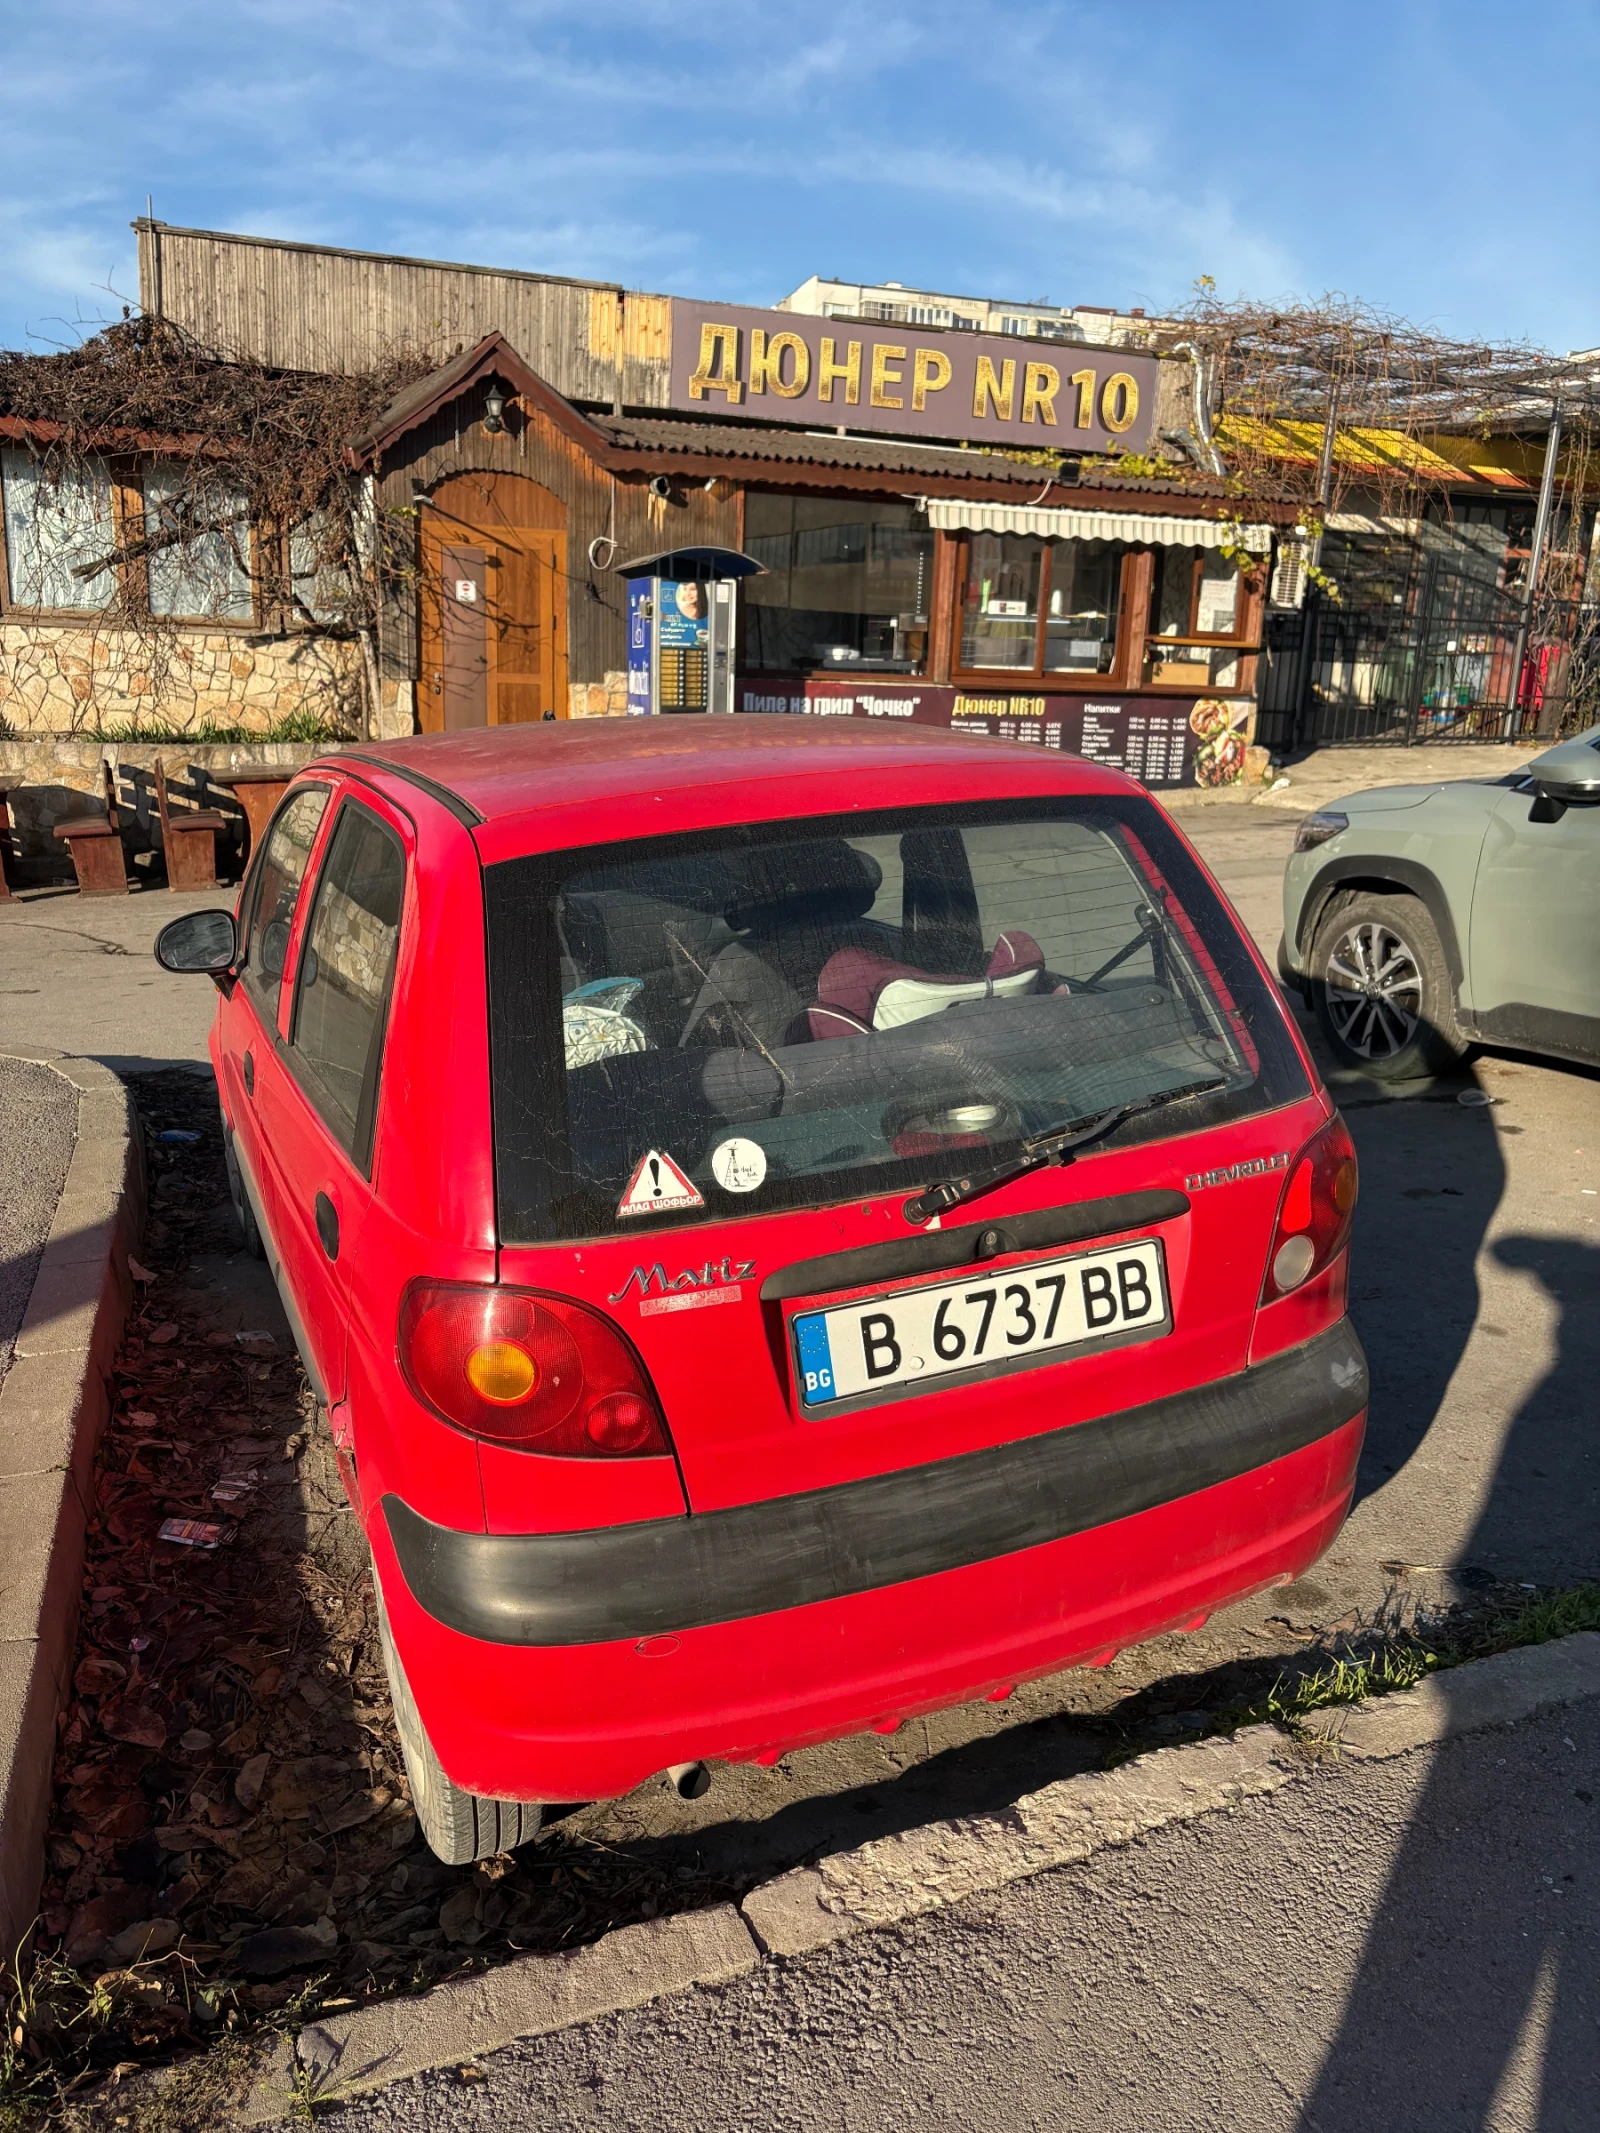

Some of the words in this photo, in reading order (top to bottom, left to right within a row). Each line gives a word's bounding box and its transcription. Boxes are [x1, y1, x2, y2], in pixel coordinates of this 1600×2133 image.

[688, 323, 953, 412] ДЮНЕР
[743, 692, 787, 713] Пиле
[789, 696, 811, 714] на
[813, 696, 855, 716] грил
[951, 695, 1008, 717] Дюнер
[1009, 696, 1046, 716] NR10
[1084, 703, 1121, 714] Напитки
[1184, 1150, 1292, 1192] CHEVROLET
[620, 1202, 650, 1214] МЛАД
[652, 1195, 700, 1210] ШОФЬОР
[607, 1255, 758, 1306] Matiz
[860, 1312, 901, 1380] B
[932, 1273, 1066, 1361] 6737
[1080, 1258, 1152, 1330] BB
[804, 1370, 831, 1392] BG
